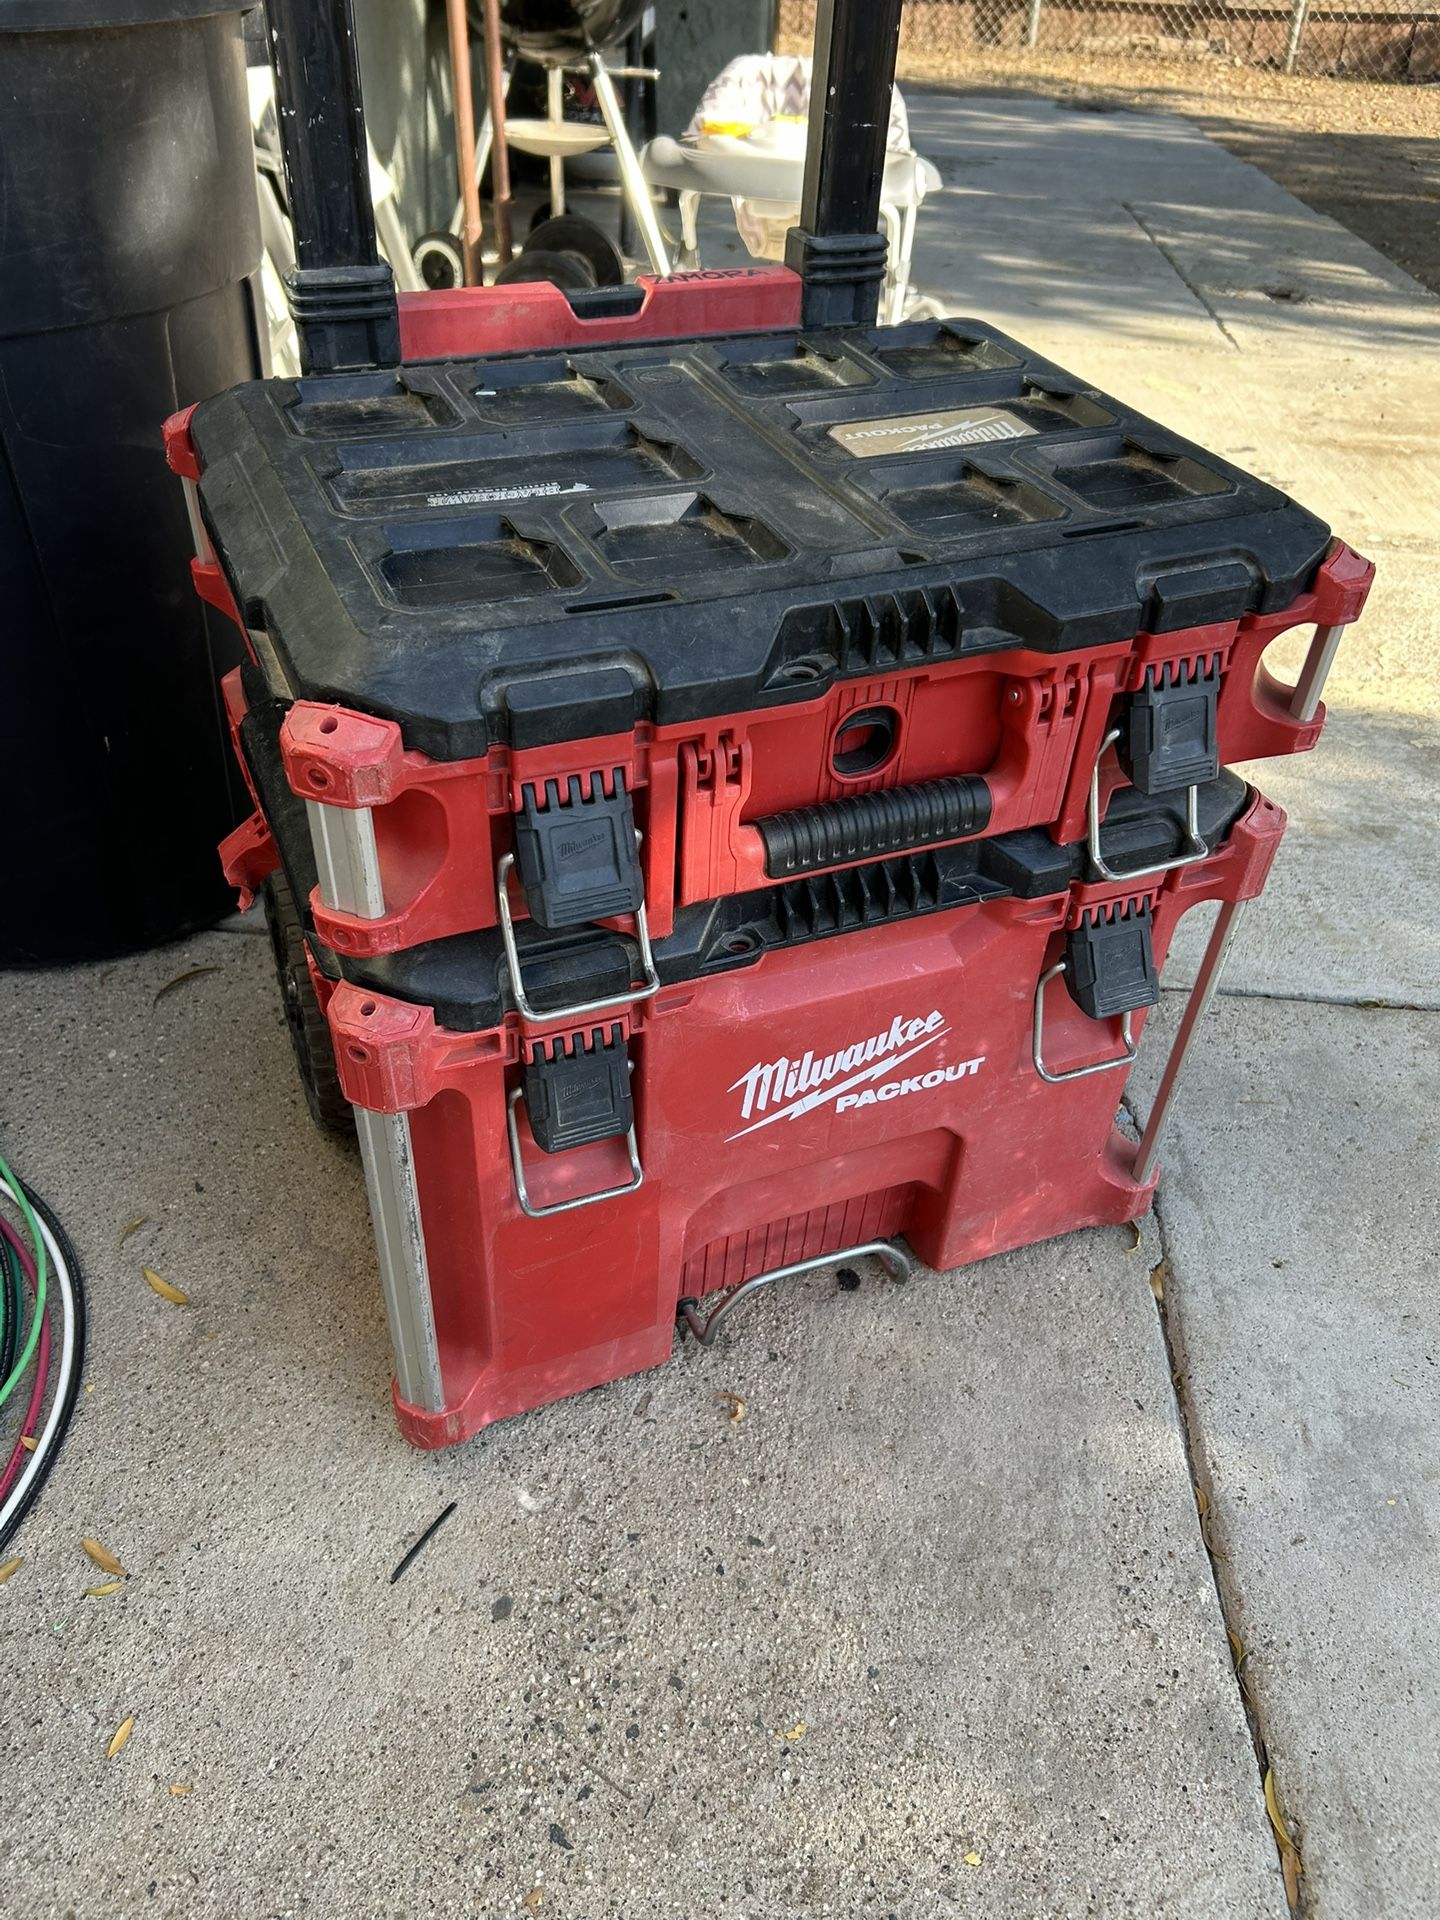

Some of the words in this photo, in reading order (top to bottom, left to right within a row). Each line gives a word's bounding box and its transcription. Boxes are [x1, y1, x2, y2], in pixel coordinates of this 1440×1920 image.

[644, 268, 768, 285] ZAMORA
[844, 422, 944, 441] PACKOUT
[427, 485, 561, 507] BLACKHAWK
[726, 1009, 946, 1120] Milwaukee
[835, 1056, 986, 1114] PACKOUT
